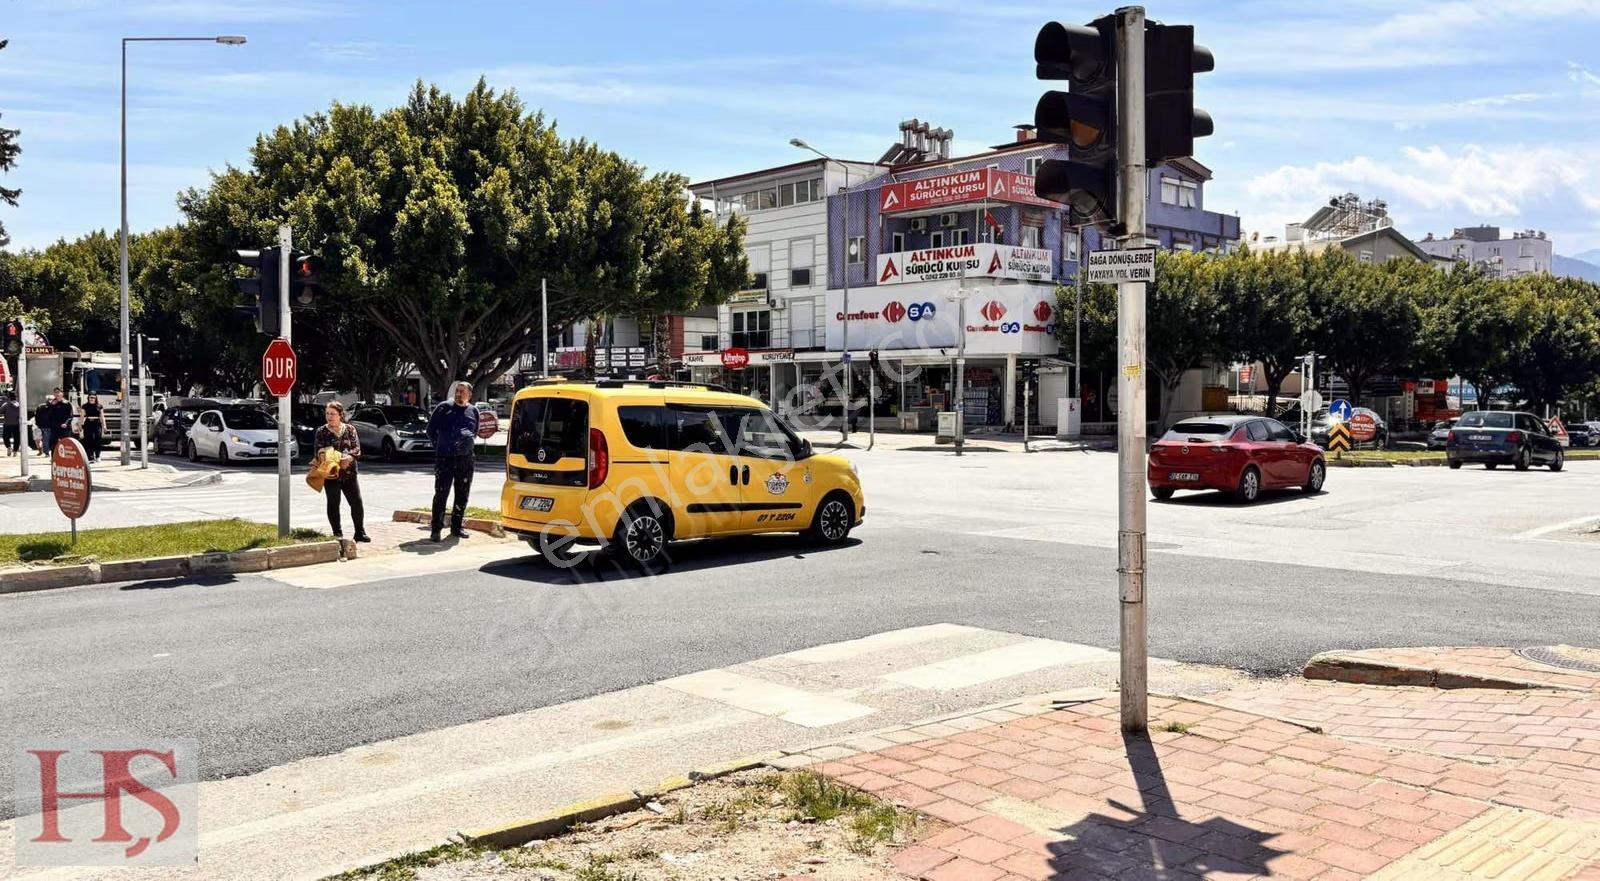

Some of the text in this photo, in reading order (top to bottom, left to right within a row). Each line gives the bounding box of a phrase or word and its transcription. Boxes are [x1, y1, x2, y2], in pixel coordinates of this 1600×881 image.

[914, 171, 981, 191] ALTINKUM
[1014, 175, 1036, 187] ALTI
[909, 188, 949, 201] SÜRÜCÜ
[951, 182, 986, 195] KURSU
[910, 245, 976, 263] ALTINKUM
[1011, 248, 1049, 262] ALTINKUM
[1089, 252, 1153, 267] SAĞA DÖNÜŞLERDE
[905, 260, 944, 275] SÜRÜCÜ
[946, 258, 980, 272] KUSU
[1089, 266, 1151, 280] YAYAYA YOL VERİN
[265, 357, 294, 379] DUR
